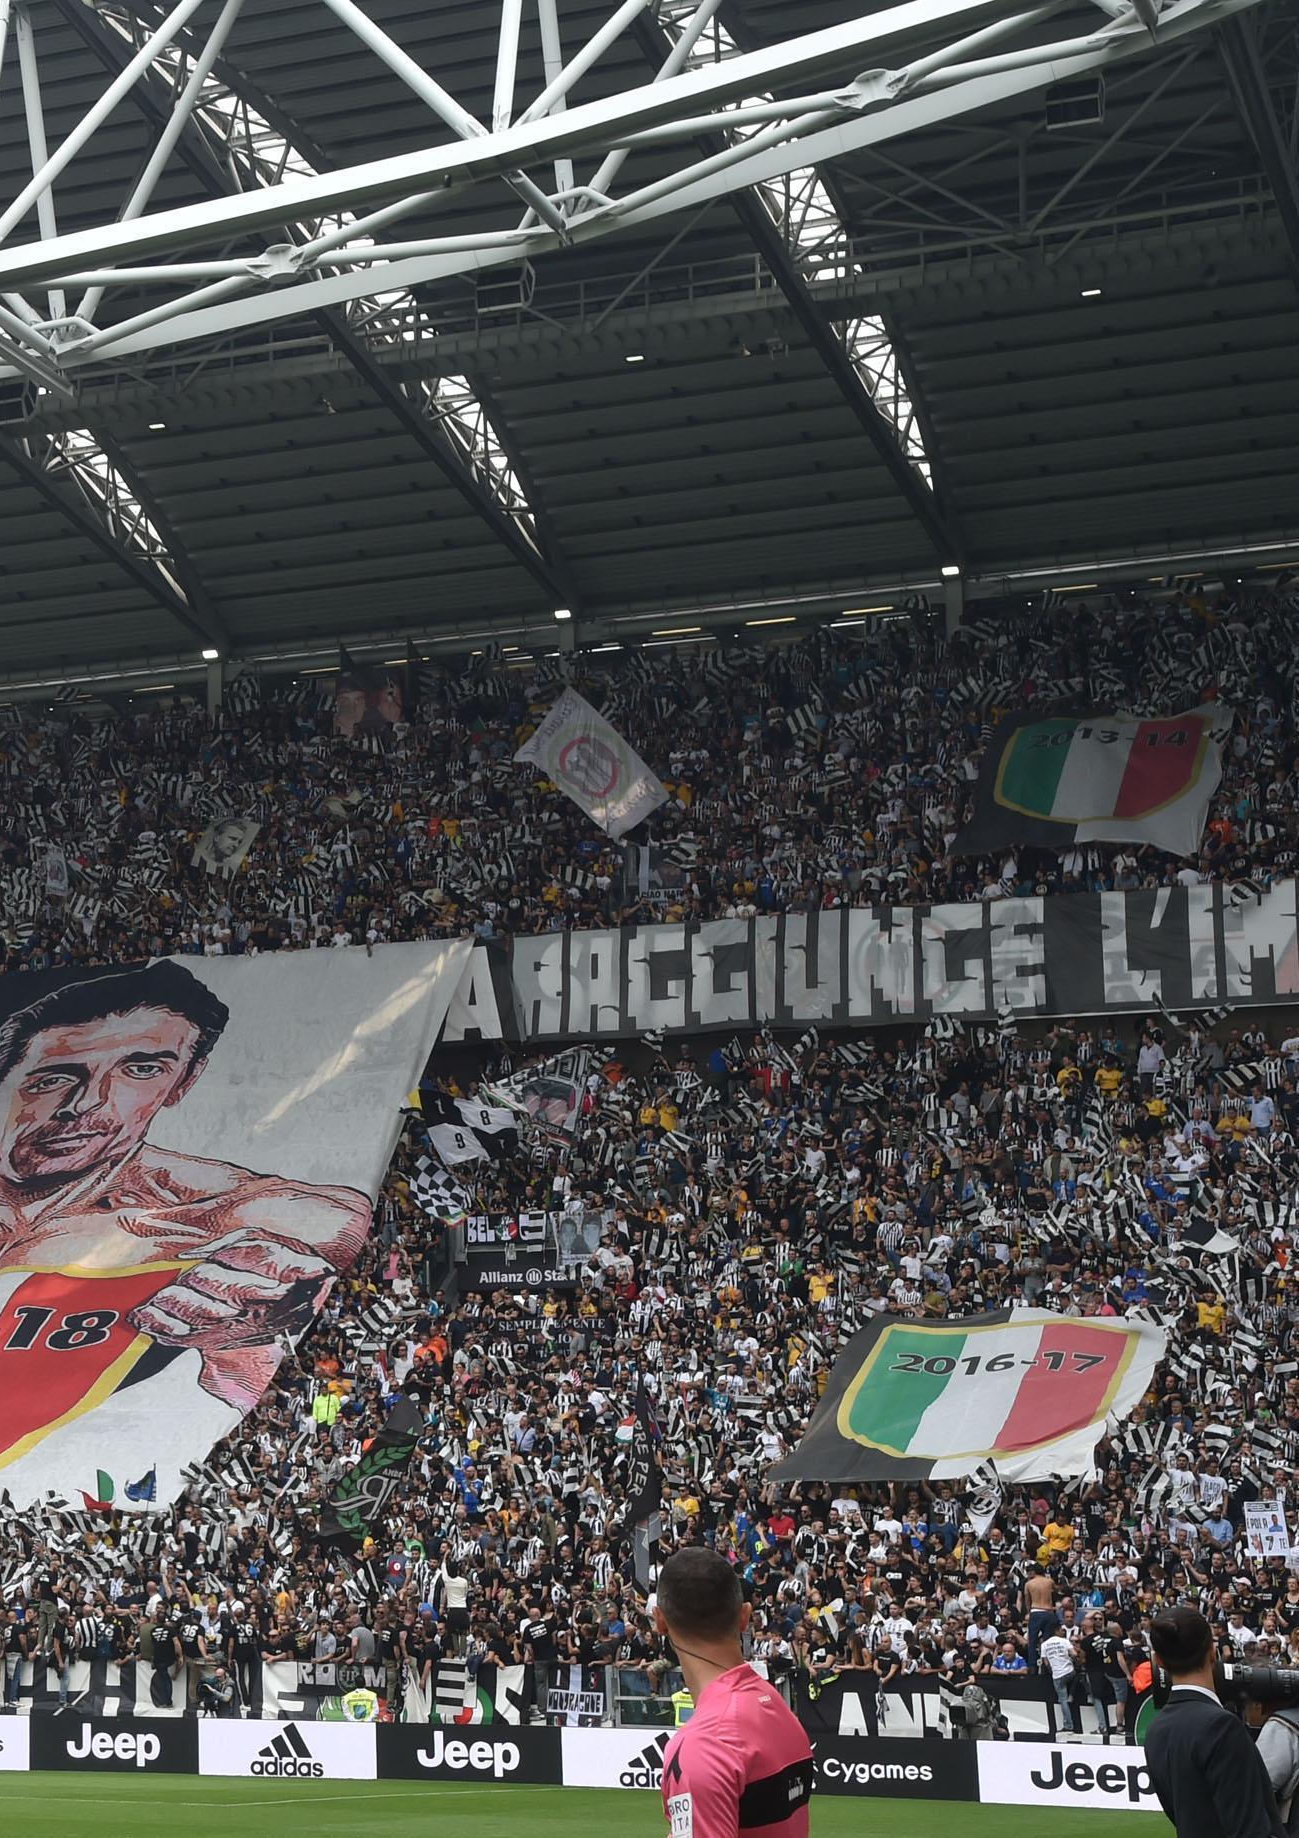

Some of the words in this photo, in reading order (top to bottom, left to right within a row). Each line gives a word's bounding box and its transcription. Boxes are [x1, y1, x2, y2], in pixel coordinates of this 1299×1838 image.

[1029, 723, 1189, 748] 2013-14
[479, 1270, 523, 1284] Allianz
[889, 1350, 1106, 1377] 2016-17
[66, 1723, 161, 1767] Jeep
[416, 1730, 521, 1777] Jeep
[250, 1756, 324, 1778] adidas
[822, 1757, 933, 1784] Cygames
[1031, 1751, 1157, 1803] Jeep
